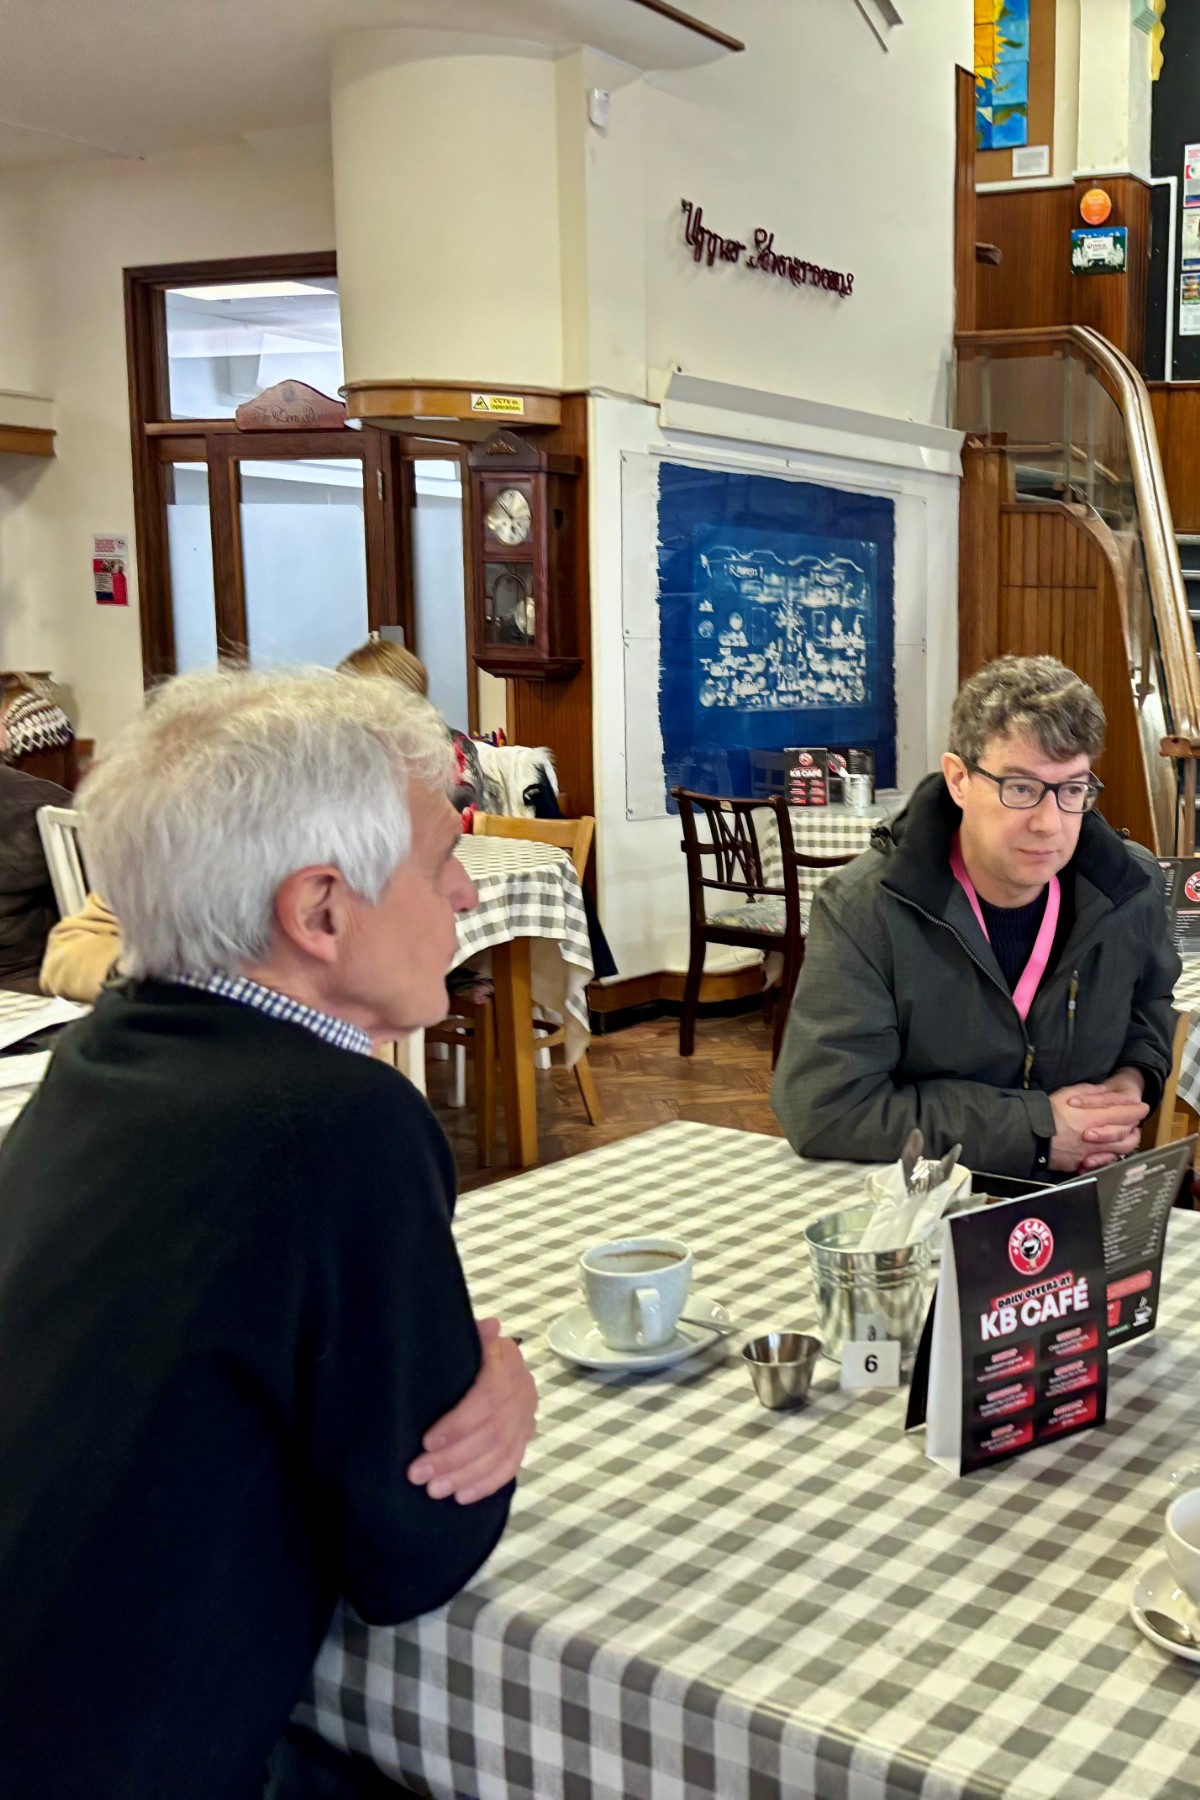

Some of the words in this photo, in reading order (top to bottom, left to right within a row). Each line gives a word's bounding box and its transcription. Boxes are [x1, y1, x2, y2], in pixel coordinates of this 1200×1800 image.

[493, 397, 511, 405] CCTV
[1011, 1229, 1025, 1248] KB
[997, 1293, 1024, 1308] DAILY
[1025, 1281, 1059, 1298] OFFERS
[1059, 1276, 1071, 1286] AT
[980, 1306, 1018, 1341] KB
[1020, 1276, 1090, 1327] CAFÉ
[864, 1354, 878, 1373] 6
